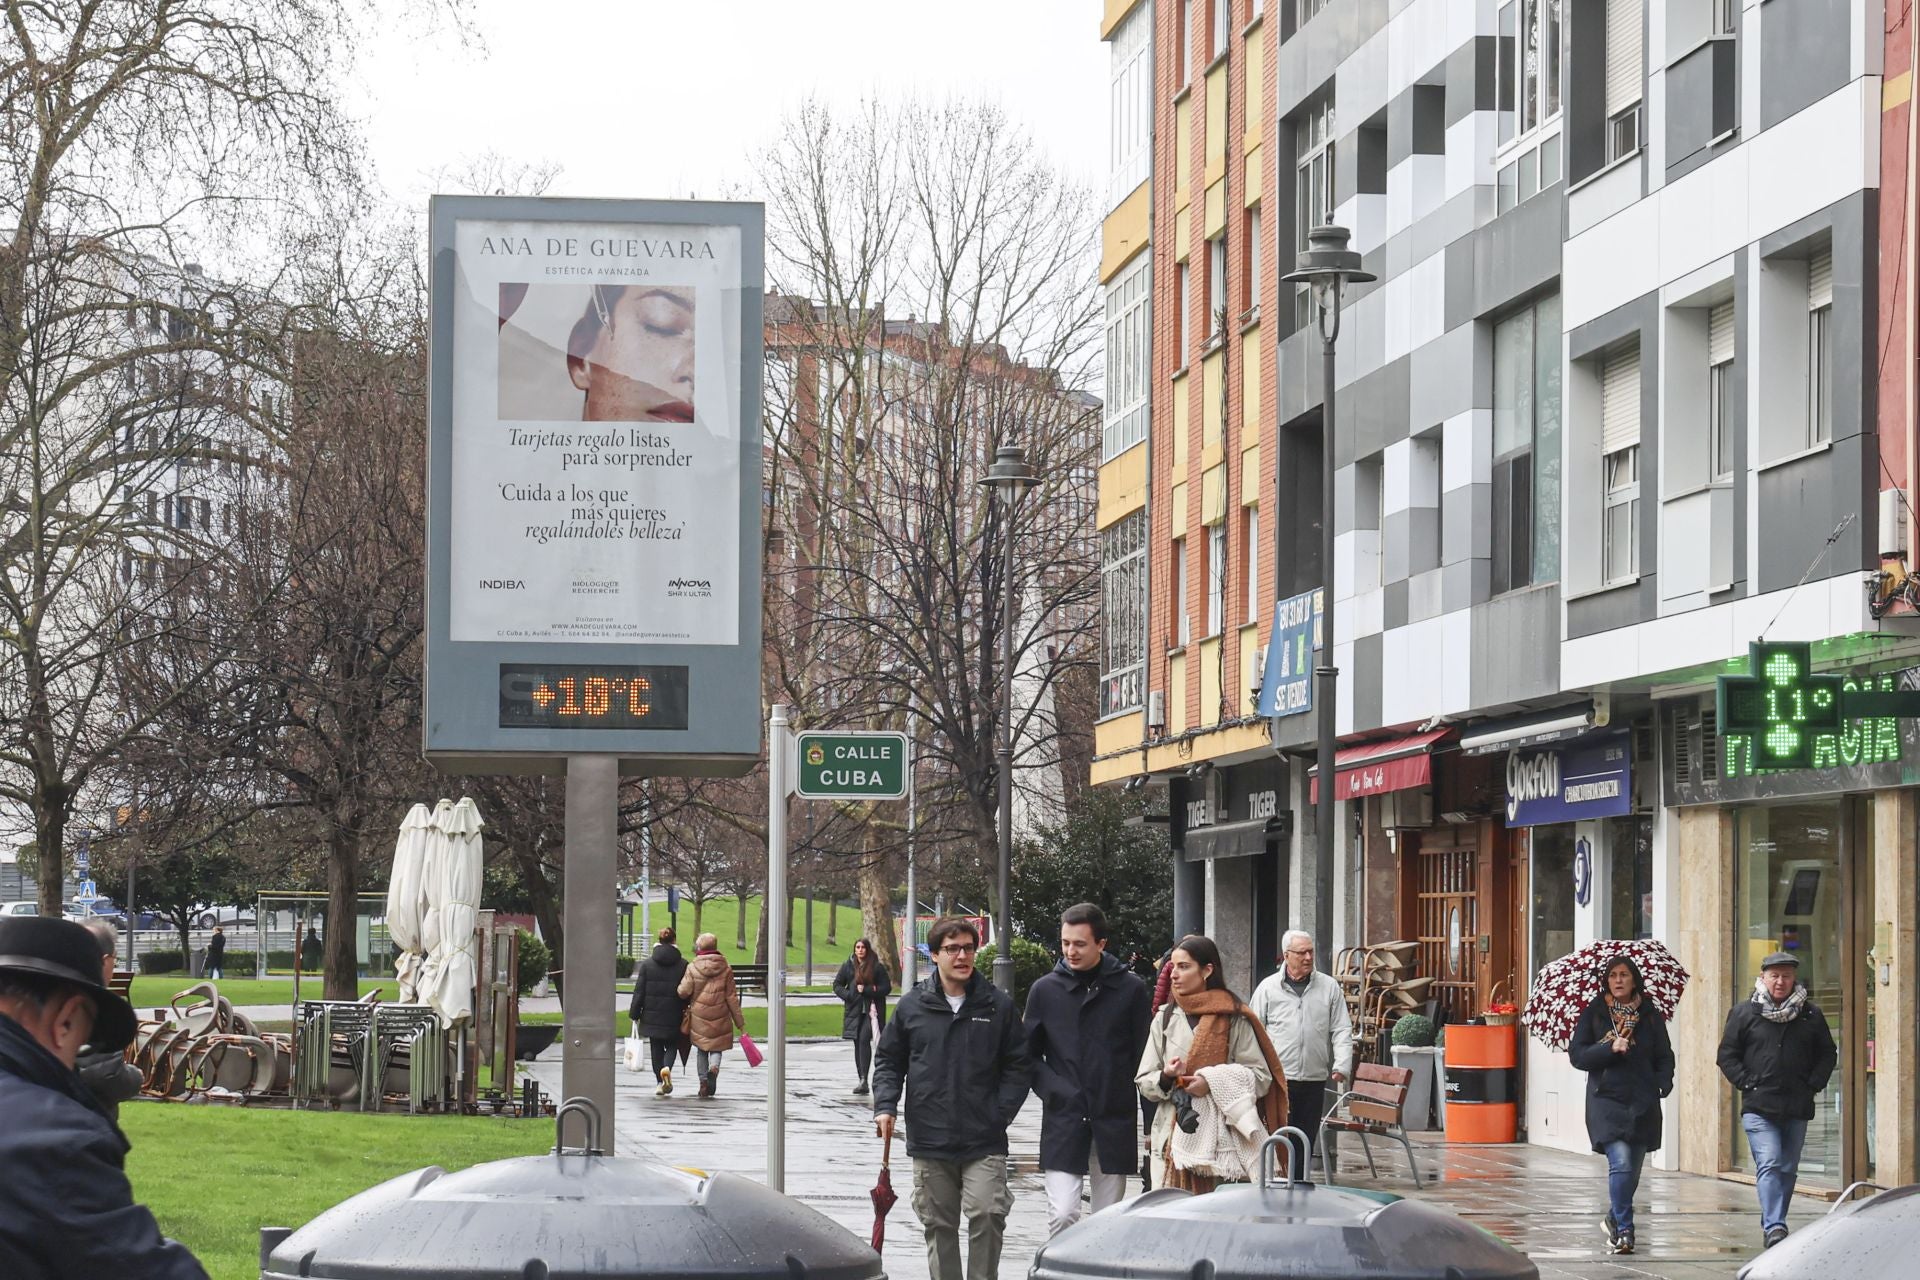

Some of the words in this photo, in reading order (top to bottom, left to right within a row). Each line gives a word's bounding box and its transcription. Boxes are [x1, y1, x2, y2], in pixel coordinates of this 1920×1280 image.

[480, 237, 533, 256] ANA
[546, 238, 578, 257] DE
[590, 239, 715, 259] GUEVARA
[545, 265, 593, 275] ESTÉTICA
[598, 267, 650, 276] AVANZADA
[509, 429, 572, 452] Tarjetas
[577, 429, 625, 453] regalo
[630, 429, 670, 448] listas
[562, 452, 599, 470] para
[604, 449, 693, 471] sorprender
[557, 489, 566, 501] a
[572, 484, 594, 501] los
[599, 489, 629, 507] que
[571, 503, 604, 520] más
[609, 504, 666, 526] quieres
[525, 520, 624, 544] regalándoles
[479, 580, 526, 590] INDIBA
[668, 577, 711, 590] INNOVA
[1274, 684, 1287, 712] SE
[1287, 679, 1307, 709] VENDE
[834, 746, 891, 759] CALLE
[820, 770, 883, 786] CUBA
[1187, 800, 1206, 828] TIGE
[1249, 791, 1277, 819] TIGER
